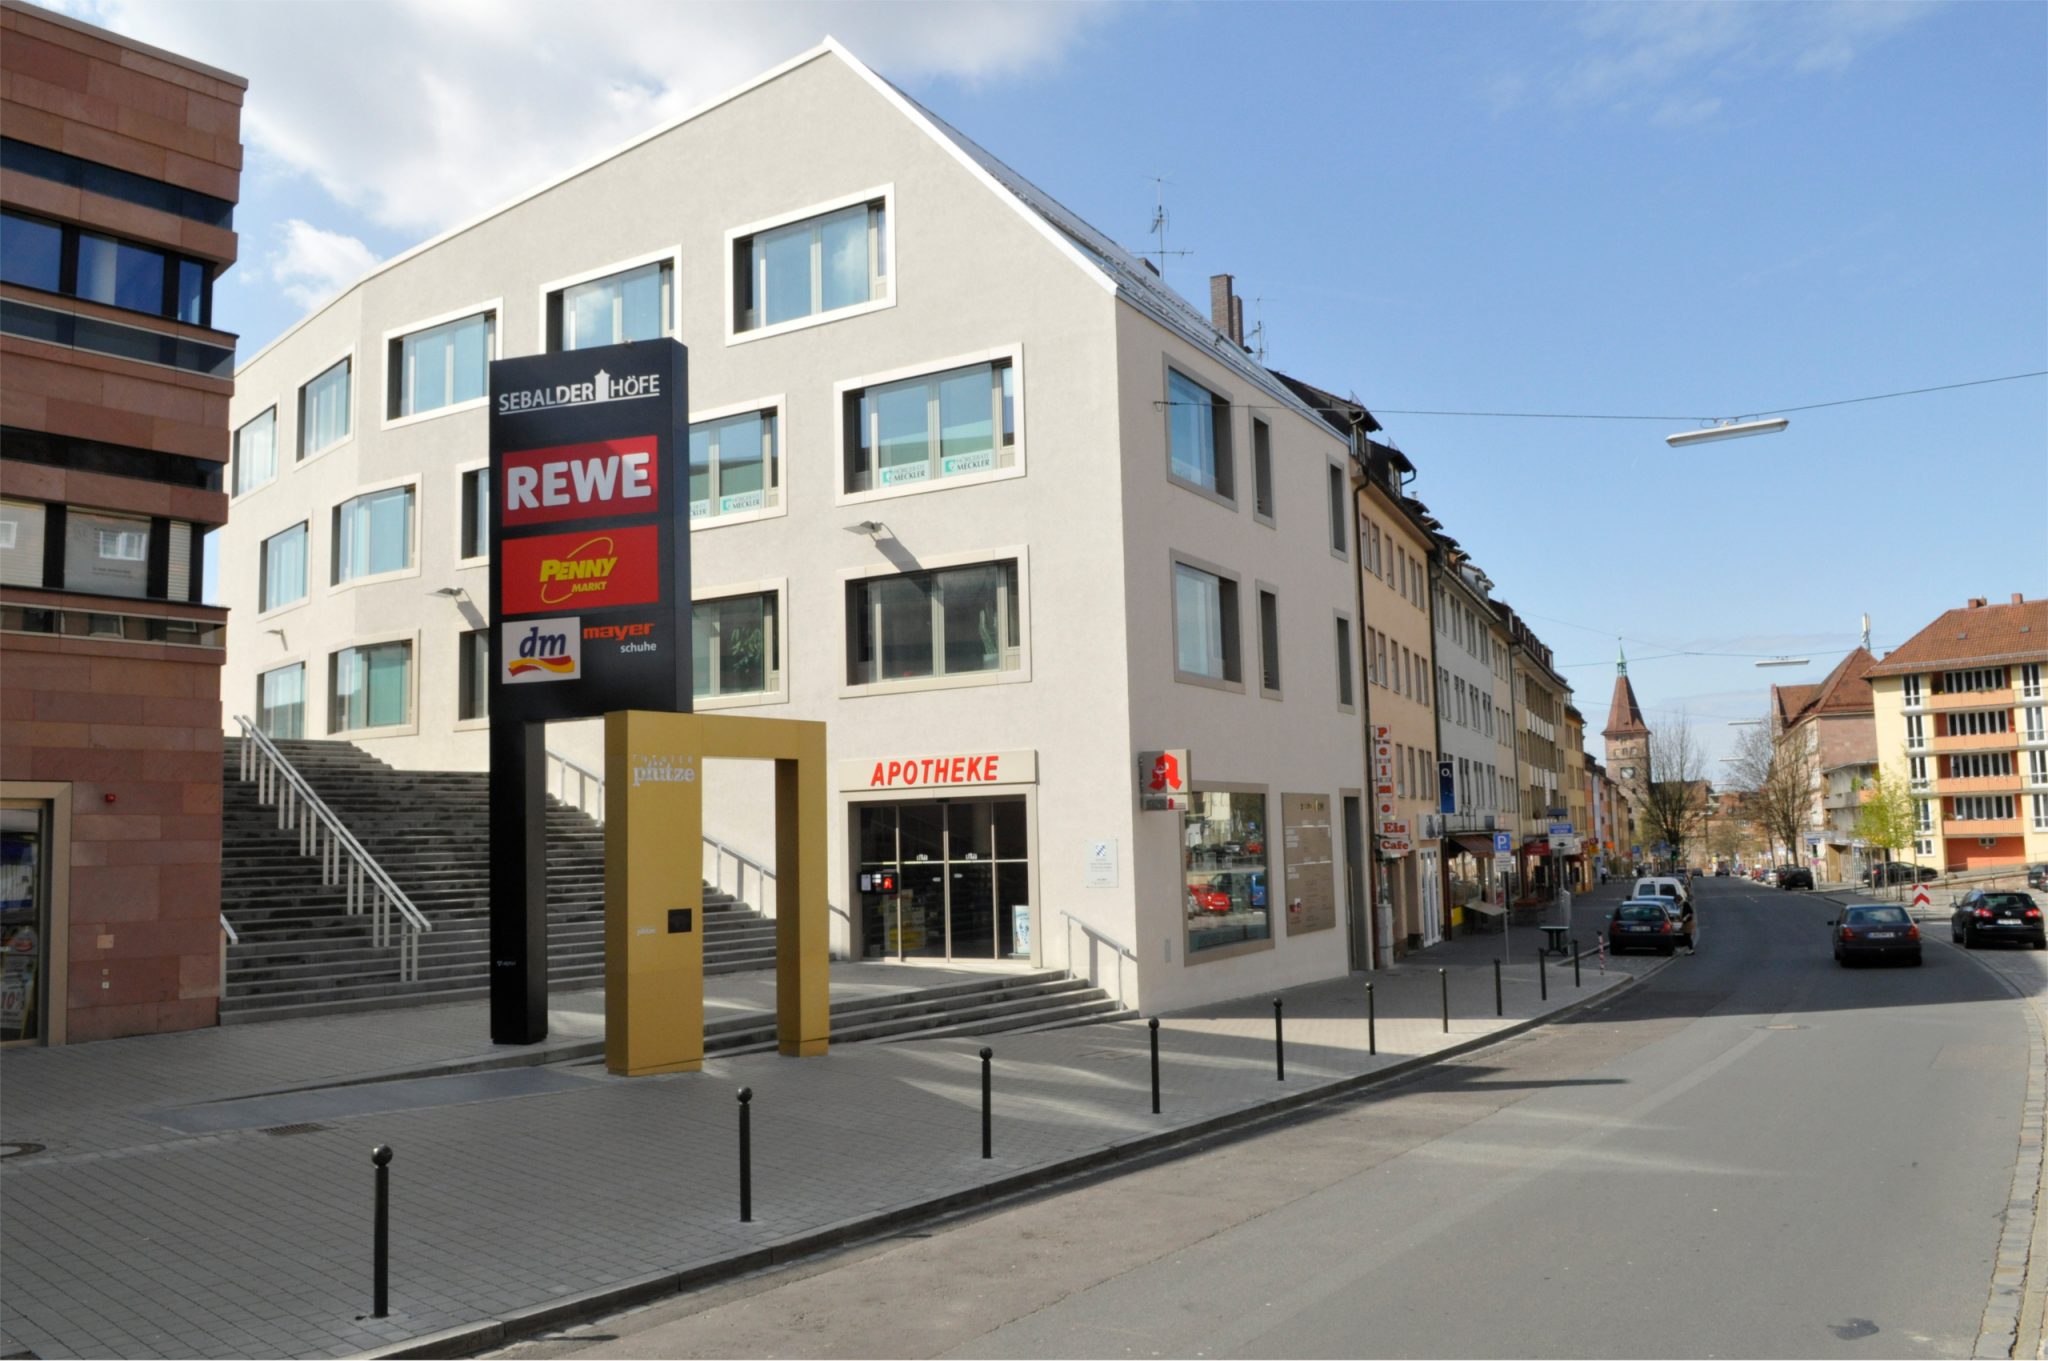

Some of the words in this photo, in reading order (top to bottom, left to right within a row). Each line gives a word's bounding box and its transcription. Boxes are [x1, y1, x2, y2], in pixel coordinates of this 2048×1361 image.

[507, 452, 652, 511] REWE
[540, 556, 618, 582] PENNY
[571, 580, 608, 593] MARKT
[519, 626, 567, 658] dm
[583, 623, 656, 641] mayer
[620, 642, 657, 654] schuhe
[870, 755, 999, 787] APOTHEKE
[1383, 822, 1406, 833] Eis
